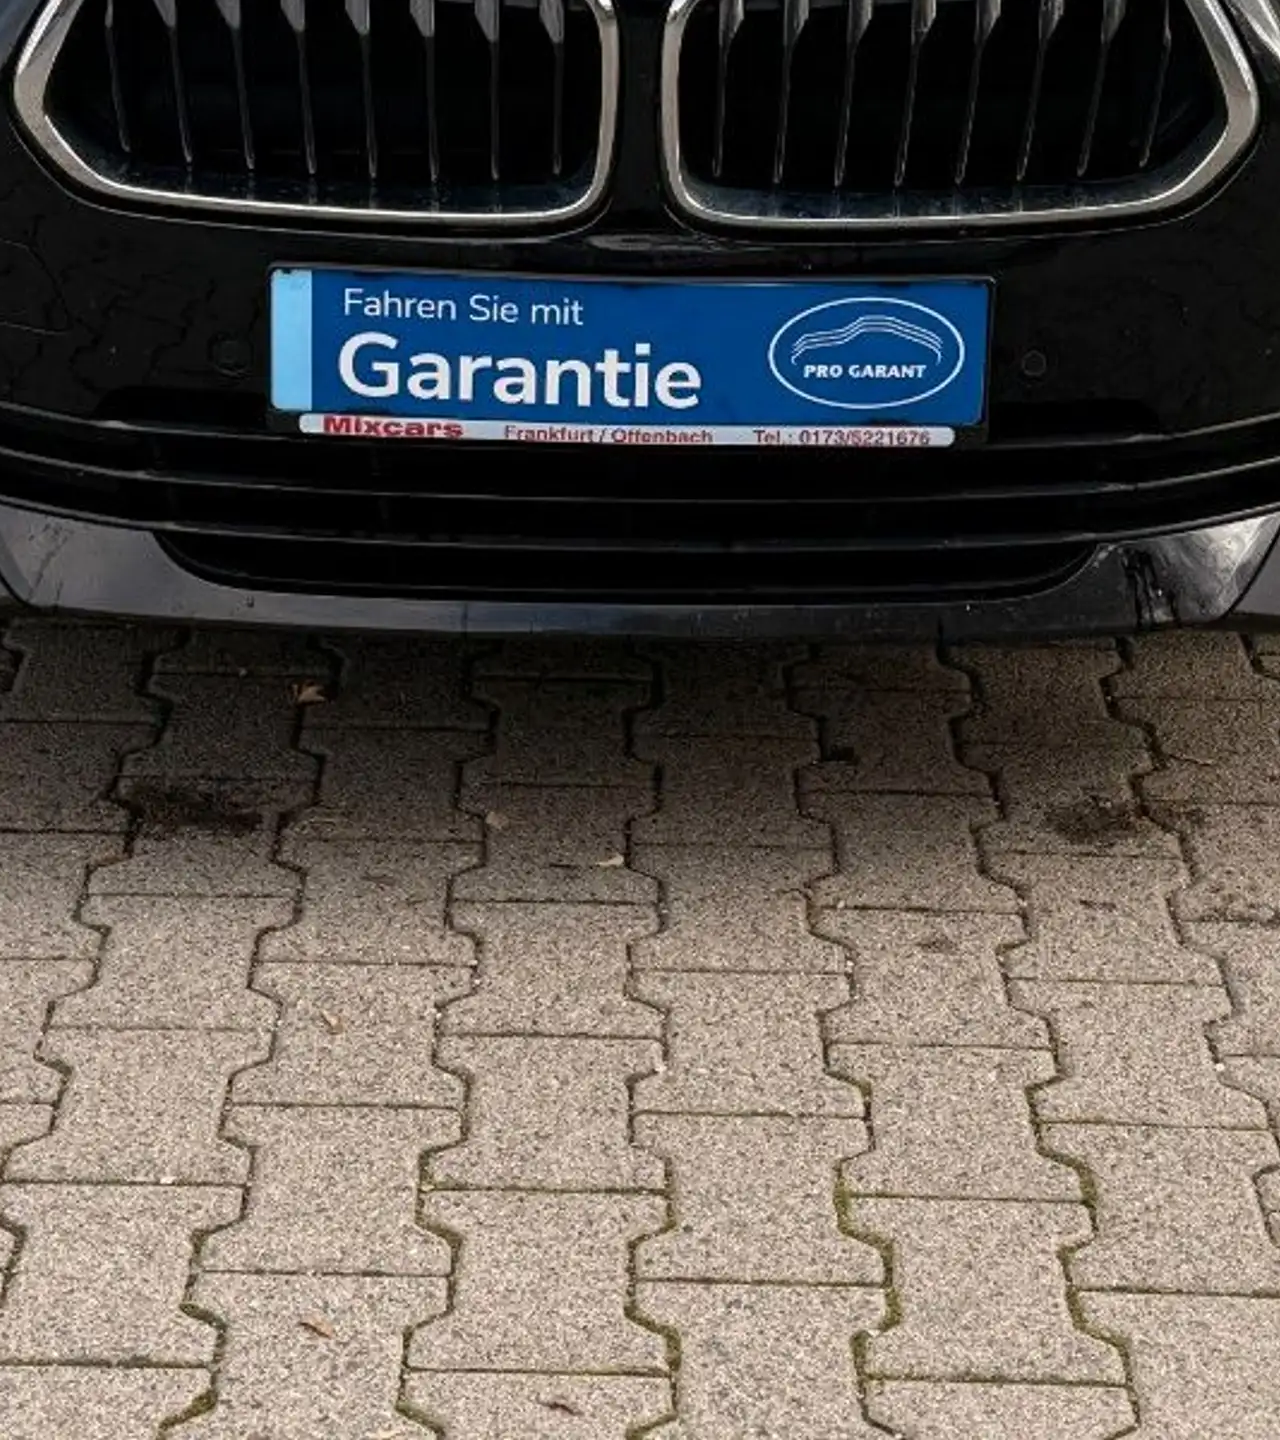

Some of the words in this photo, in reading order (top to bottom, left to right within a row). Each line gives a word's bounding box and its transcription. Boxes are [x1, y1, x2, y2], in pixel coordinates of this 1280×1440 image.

[344, 288, 457, 320] Fahren
[469, 294, 519, 323] Sie
[531, 298, 583, 326] mit
[338, 331, 702, 409] Garantie
[803, 364, 843, 379] PRO
[848, 364, 927, 380] GARANT
[323, 416, 464, 439] Mixcars
[504, 425, 594, 443] Frankfurt
[609, 428, 713, 444] Offenbach
[799, 430, 931, 446] 0173/5221676
